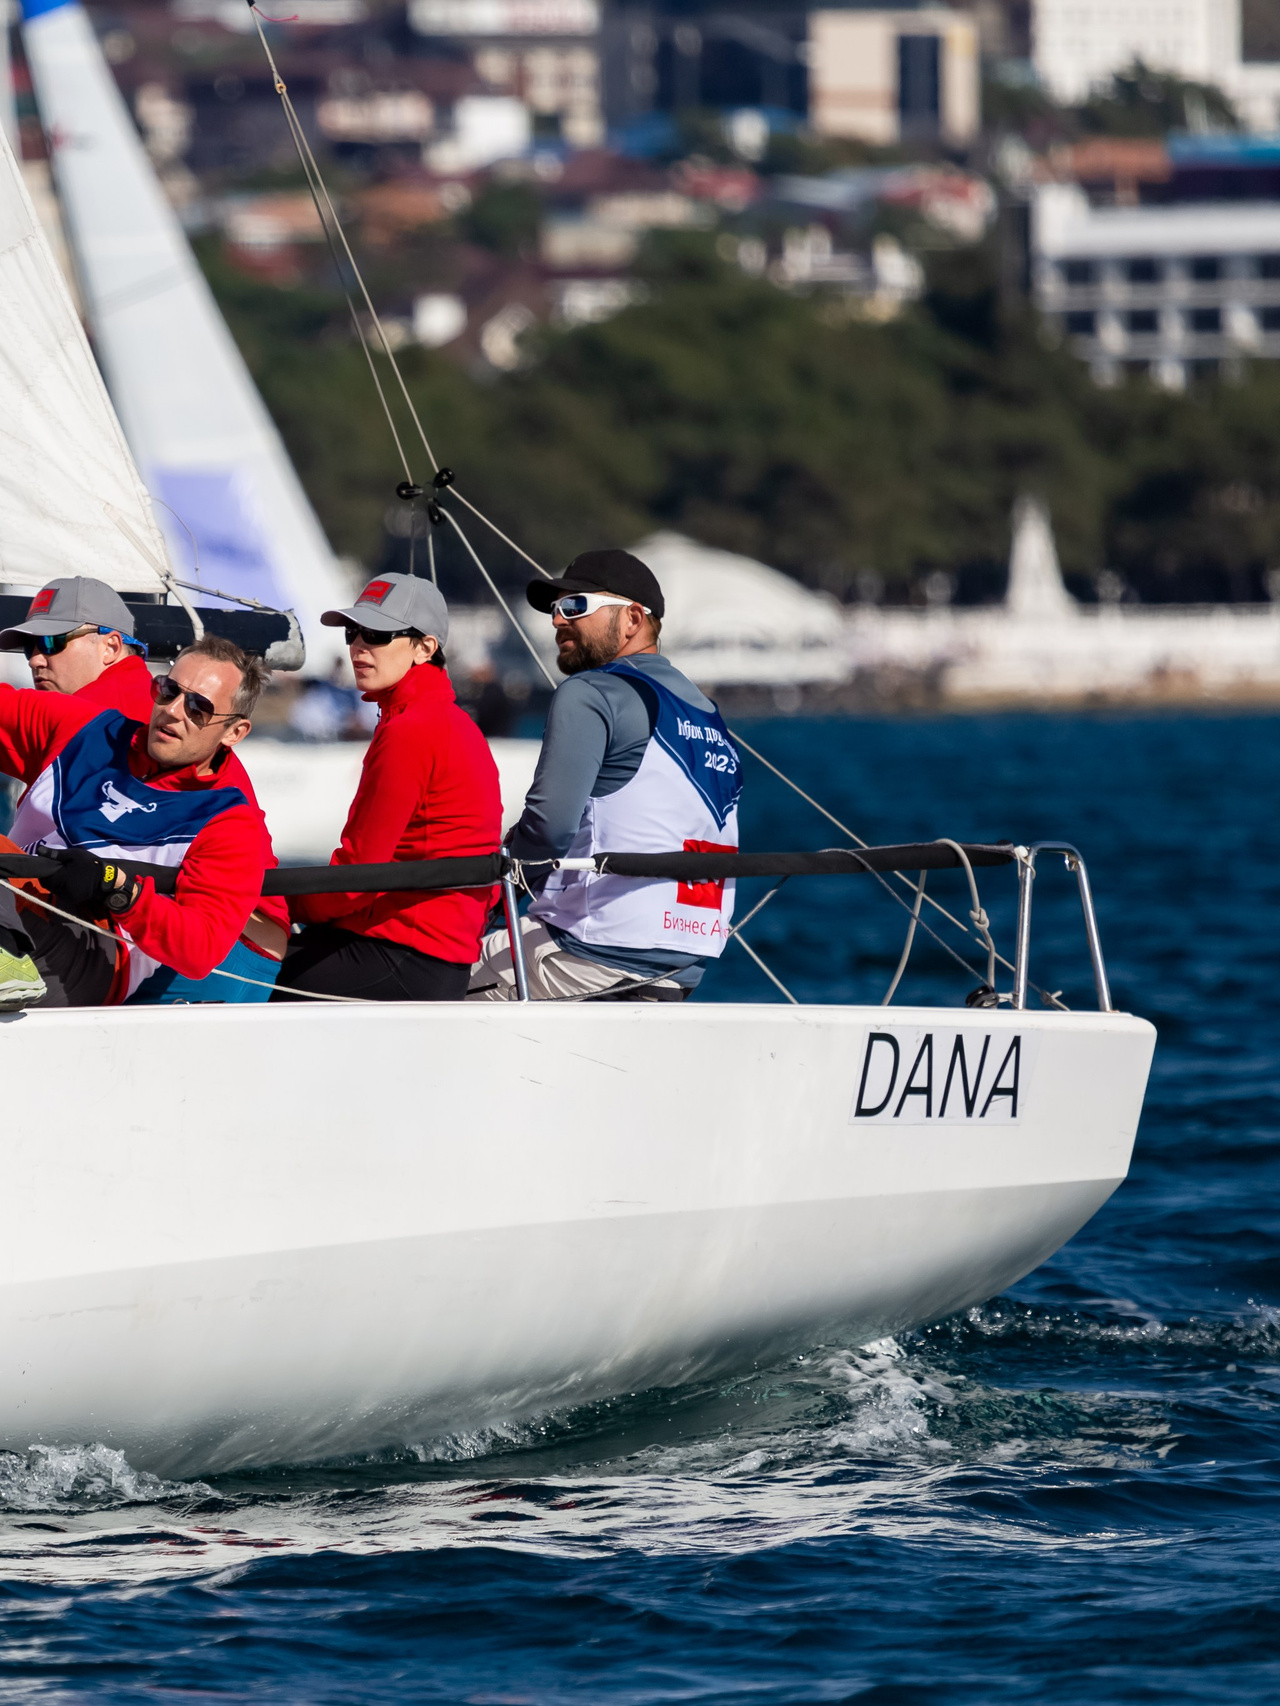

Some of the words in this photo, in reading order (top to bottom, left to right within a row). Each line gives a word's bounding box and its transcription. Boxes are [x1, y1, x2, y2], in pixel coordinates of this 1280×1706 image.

[704, 751, 737, 774] 2023
[663, 911, 706, 936] Бизнес
[854, 1032, 1022, 1118] DANA
